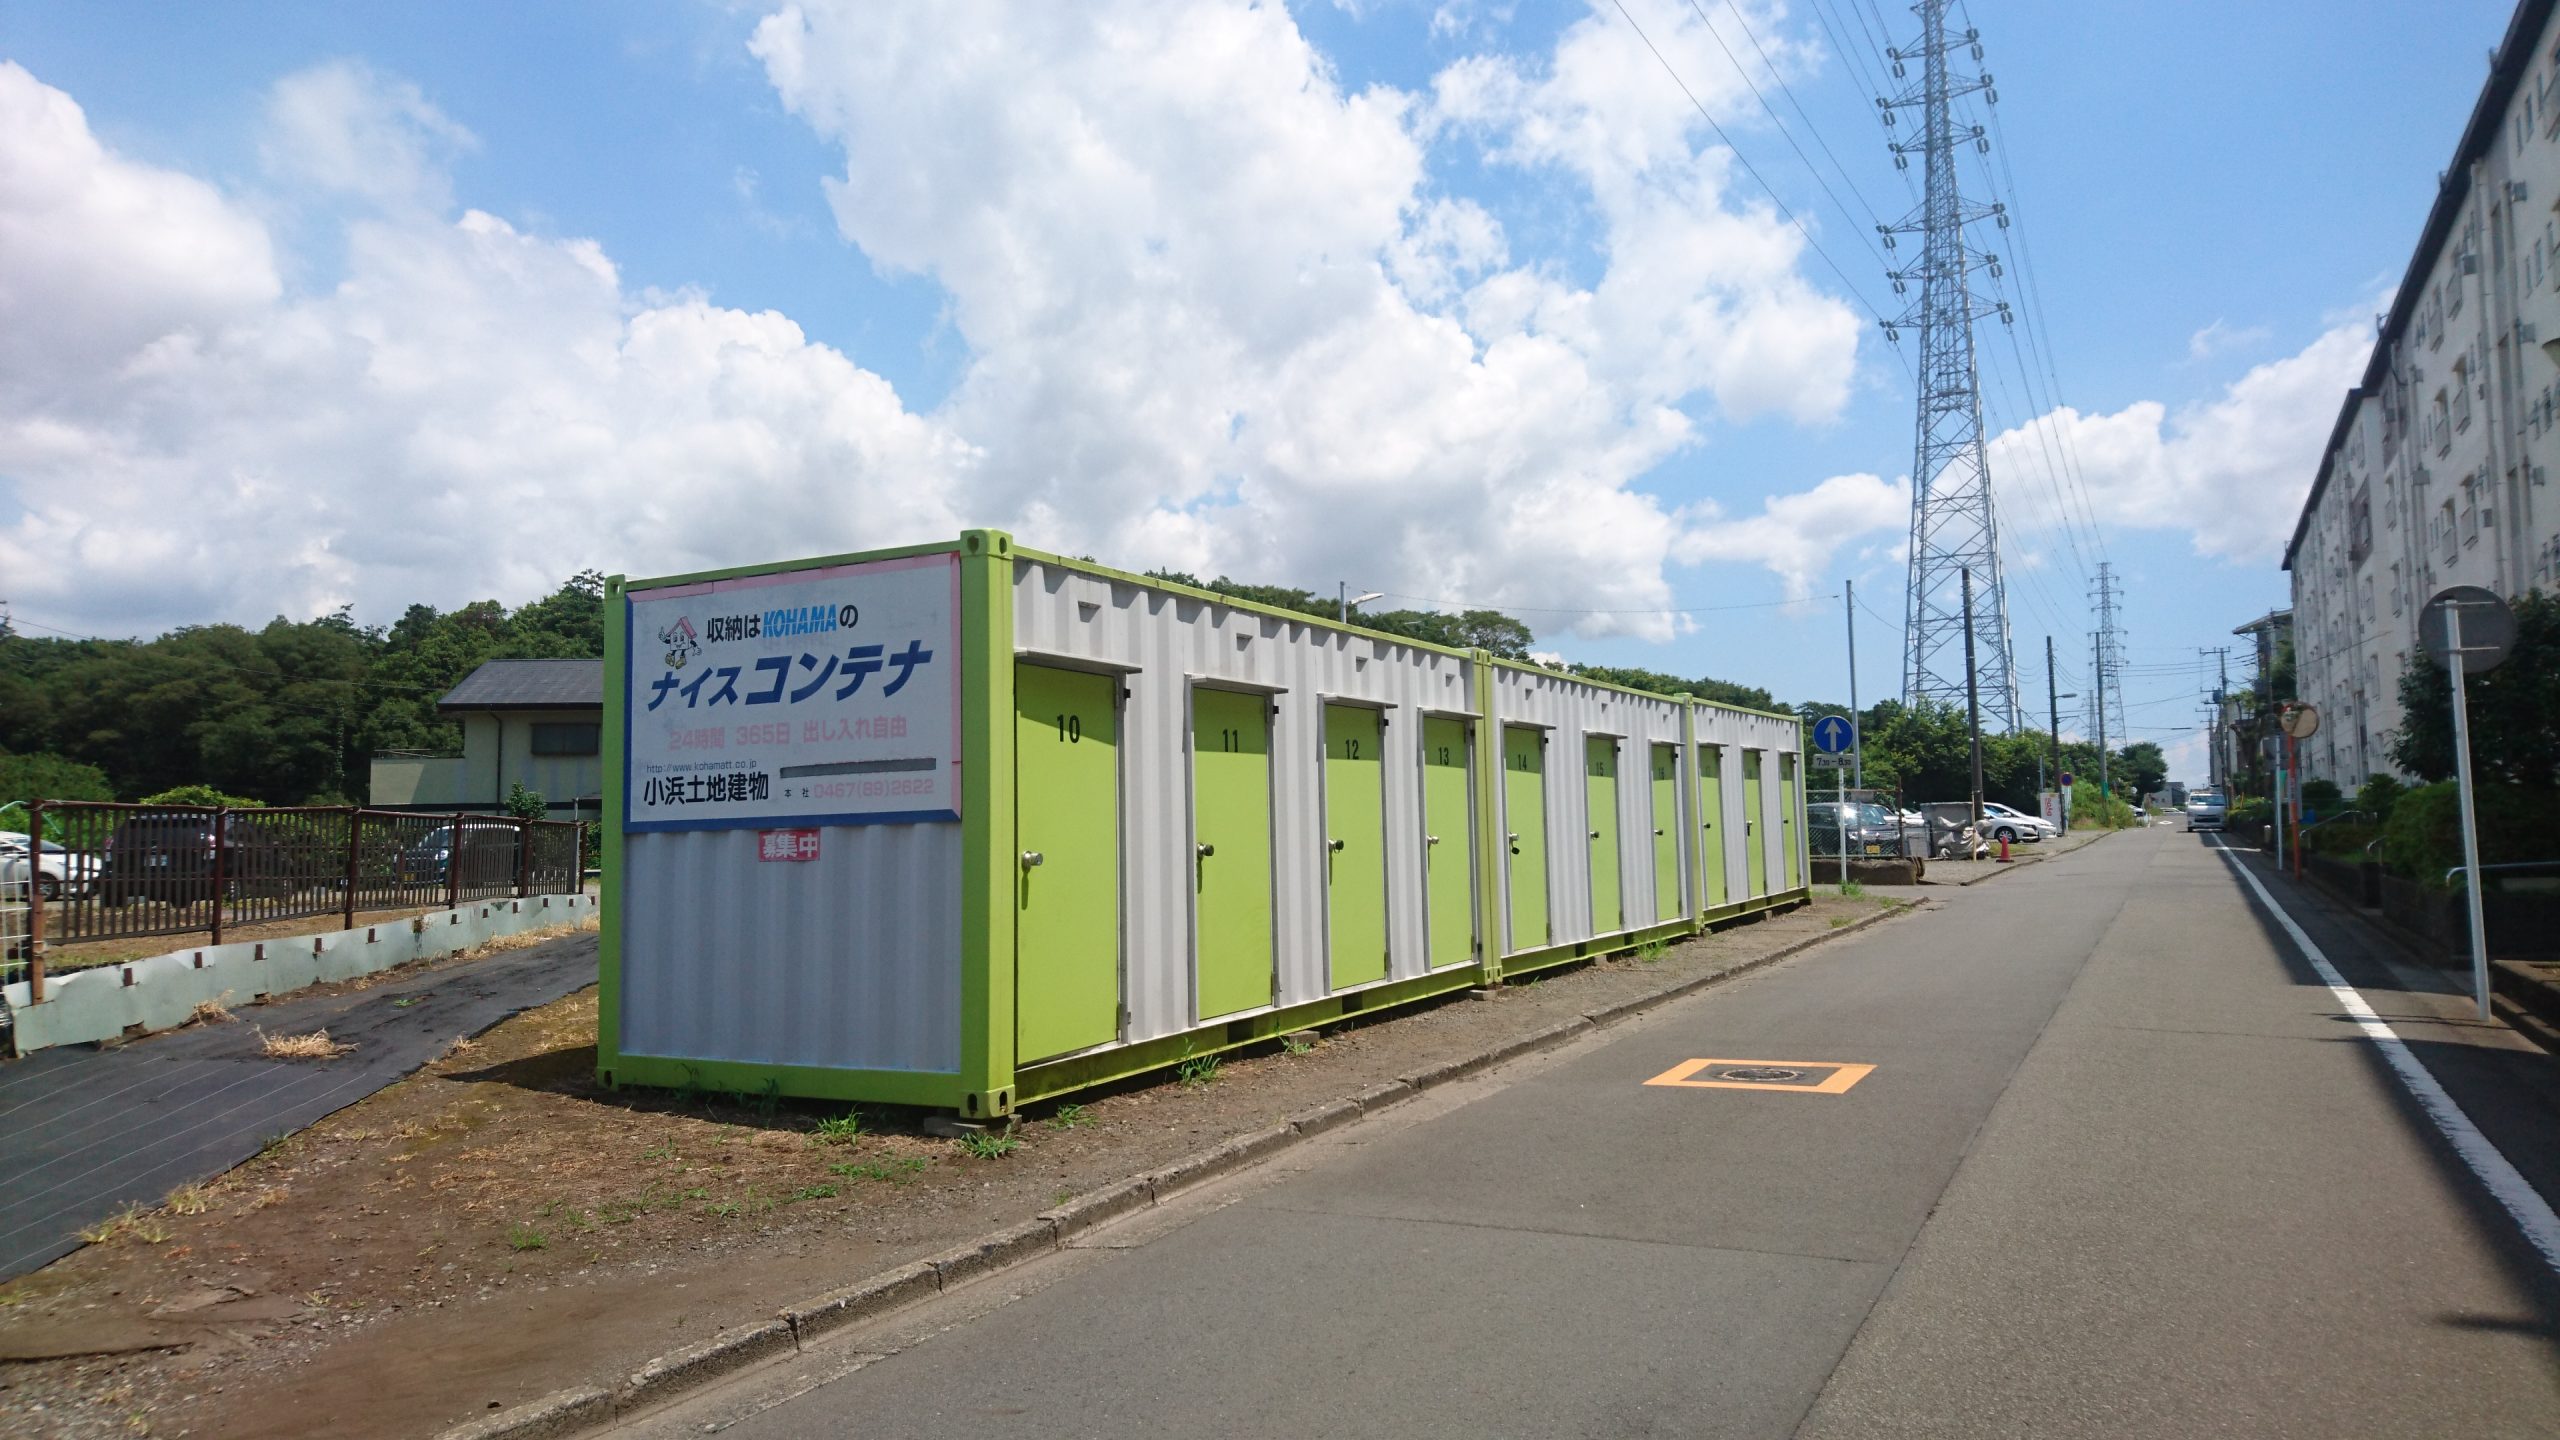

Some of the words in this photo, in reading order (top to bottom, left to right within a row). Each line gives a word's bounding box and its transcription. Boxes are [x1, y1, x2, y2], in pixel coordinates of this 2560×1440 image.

[647, 639, 934, 712] ナイスコンテナ
[669, 726, 726, 750] 24時間
[735, 722, 791, 746] 365日
[803, 714, 908, 744] 出し入れ自由
[1056, 713, 1080, 744] 10
[1222, 728, 1239, 753] 11
[1345, 739, 1360, 760] 12
[1438, 747, 1450, 766] 13
[1517, 754, 1528, 771] 14
[643, 771, 769, 806] 小浜土地建物
[762, 832, 819, 858] 募集中
